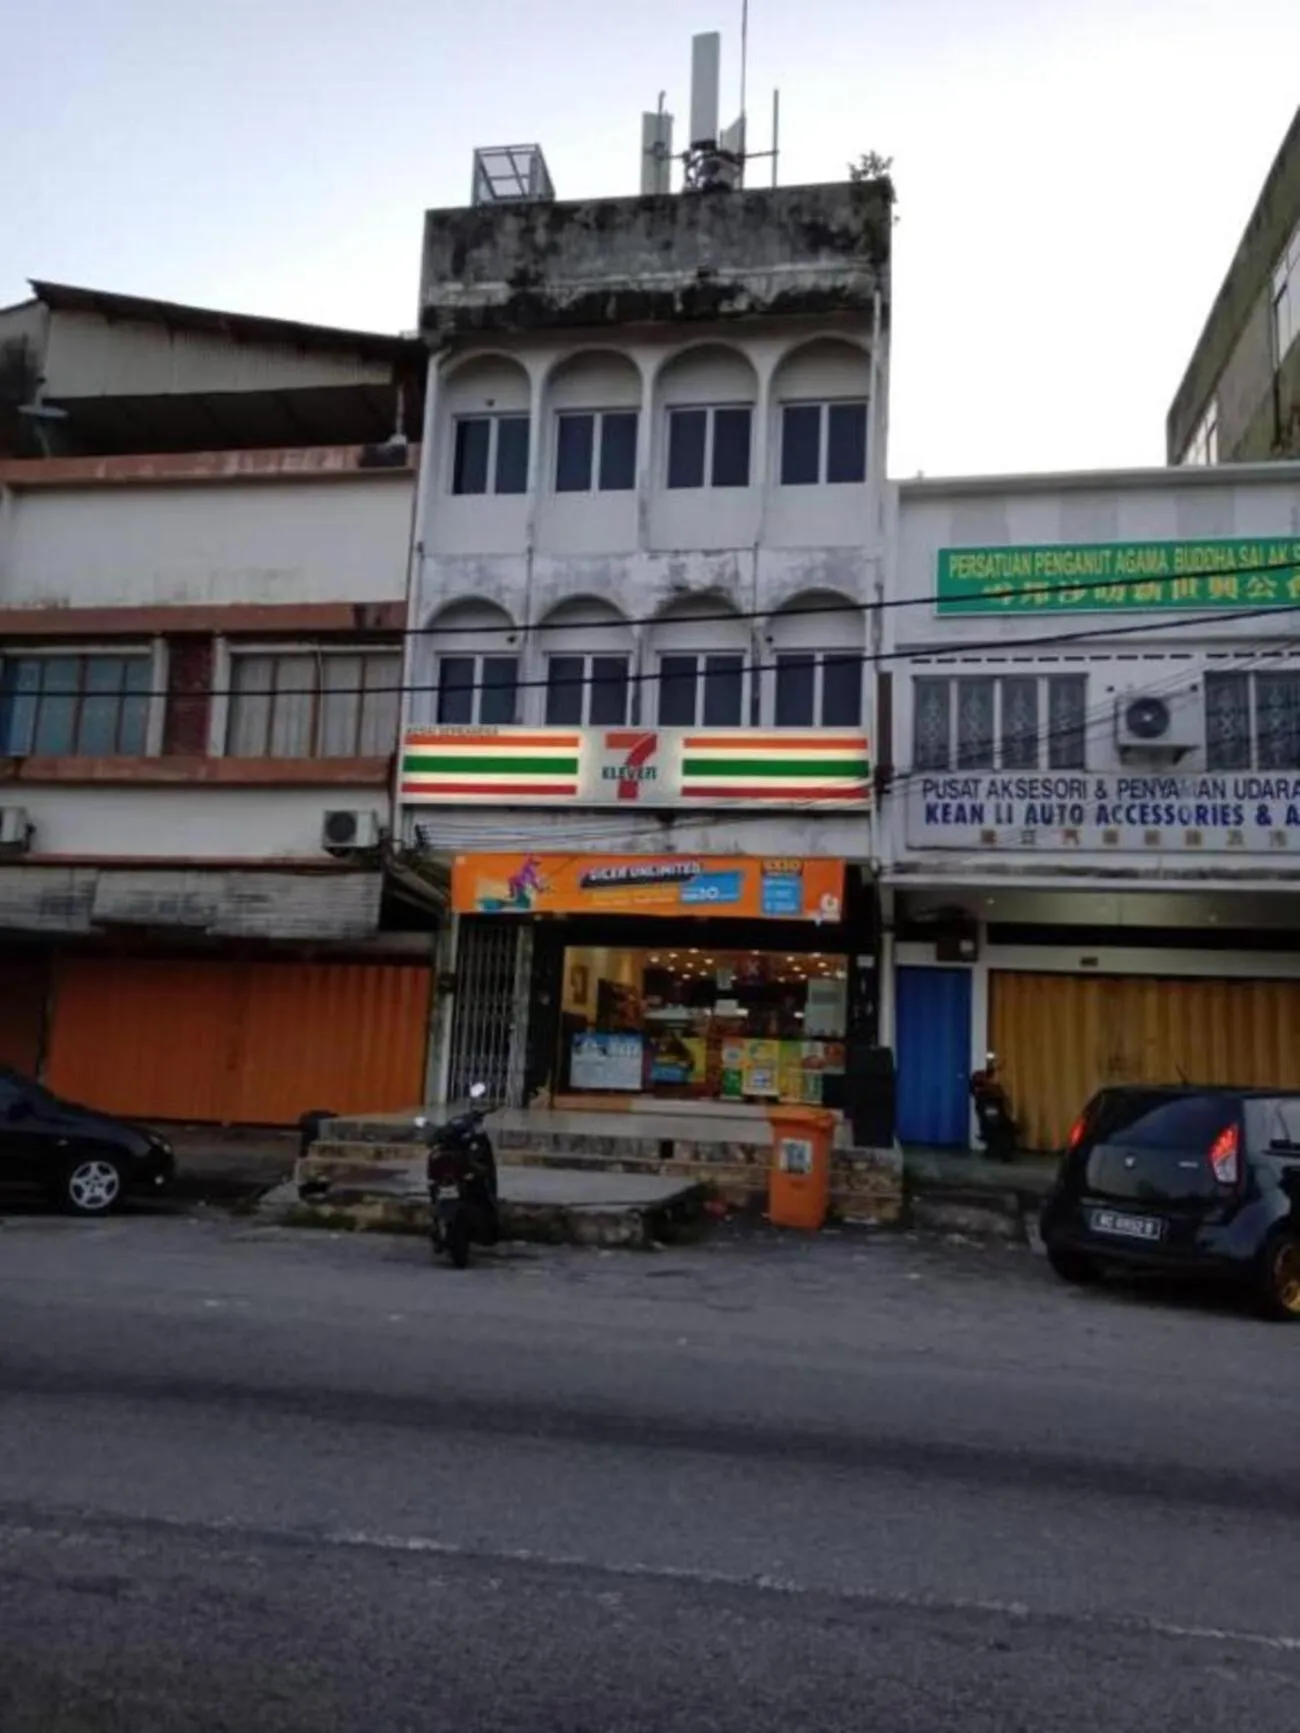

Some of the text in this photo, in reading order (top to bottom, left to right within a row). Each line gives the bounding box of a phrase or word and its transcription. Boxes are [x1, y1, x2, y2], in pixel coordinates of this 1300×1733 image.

[950, 552, 1032, 578] PERSATUAN
[1035, 549, 1111, 575] PENGANUT
[1115, 548, 1168, 574] AGAMA
[1174, 546, 1236, 571] BUDDHA
[605, 732, 657, 799] 7
[922, 778, 981, 799] PUSAT
[986, 778, 1087, 799] AKSESORI
[1095, 778, 1107, 799] &
[1117, 778, 1226, 800] PENYAAN
[925, 803, 984, 826] KEAN
[995, 803, 1014, 826] LI
[1025, 803, 1084, 826] AUTO
[1095, 803, 1245, 826] ACCESSORIES
[1256, 803, 1272, 826] &
